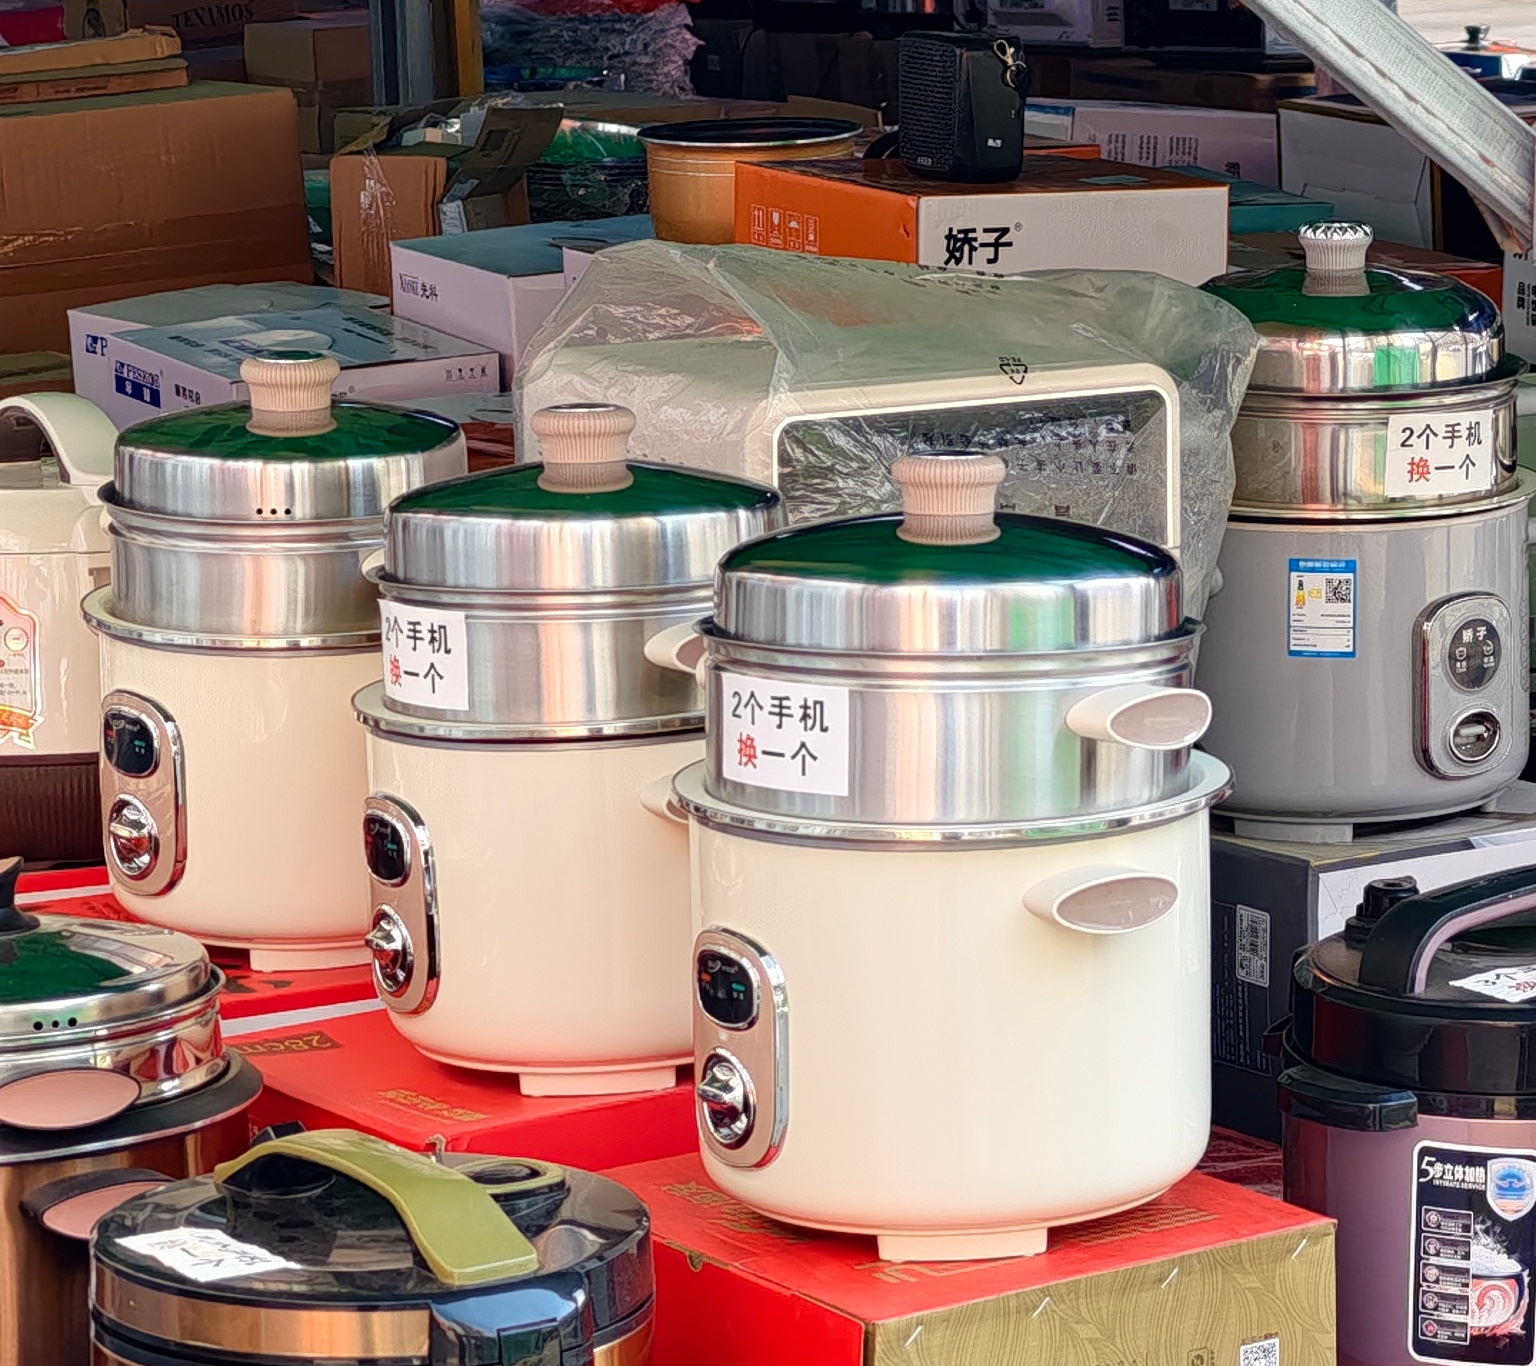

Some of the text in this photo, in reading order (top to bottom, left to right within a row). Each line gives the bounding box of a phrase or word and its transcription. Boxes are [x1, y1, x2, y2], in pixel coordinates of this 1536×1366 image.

[944, 225, 1014, 267] 娇子
[1400, 422, 1483, 450] 2个手机
[1407, 453, 1477, 484] 换一个
[384, 615, 452, 656] 2个手机
[389, 657, 444, 694] 换一个
[730, 690, 830, 734] 2个手机
[736, 732, 819, 777] 换一个
